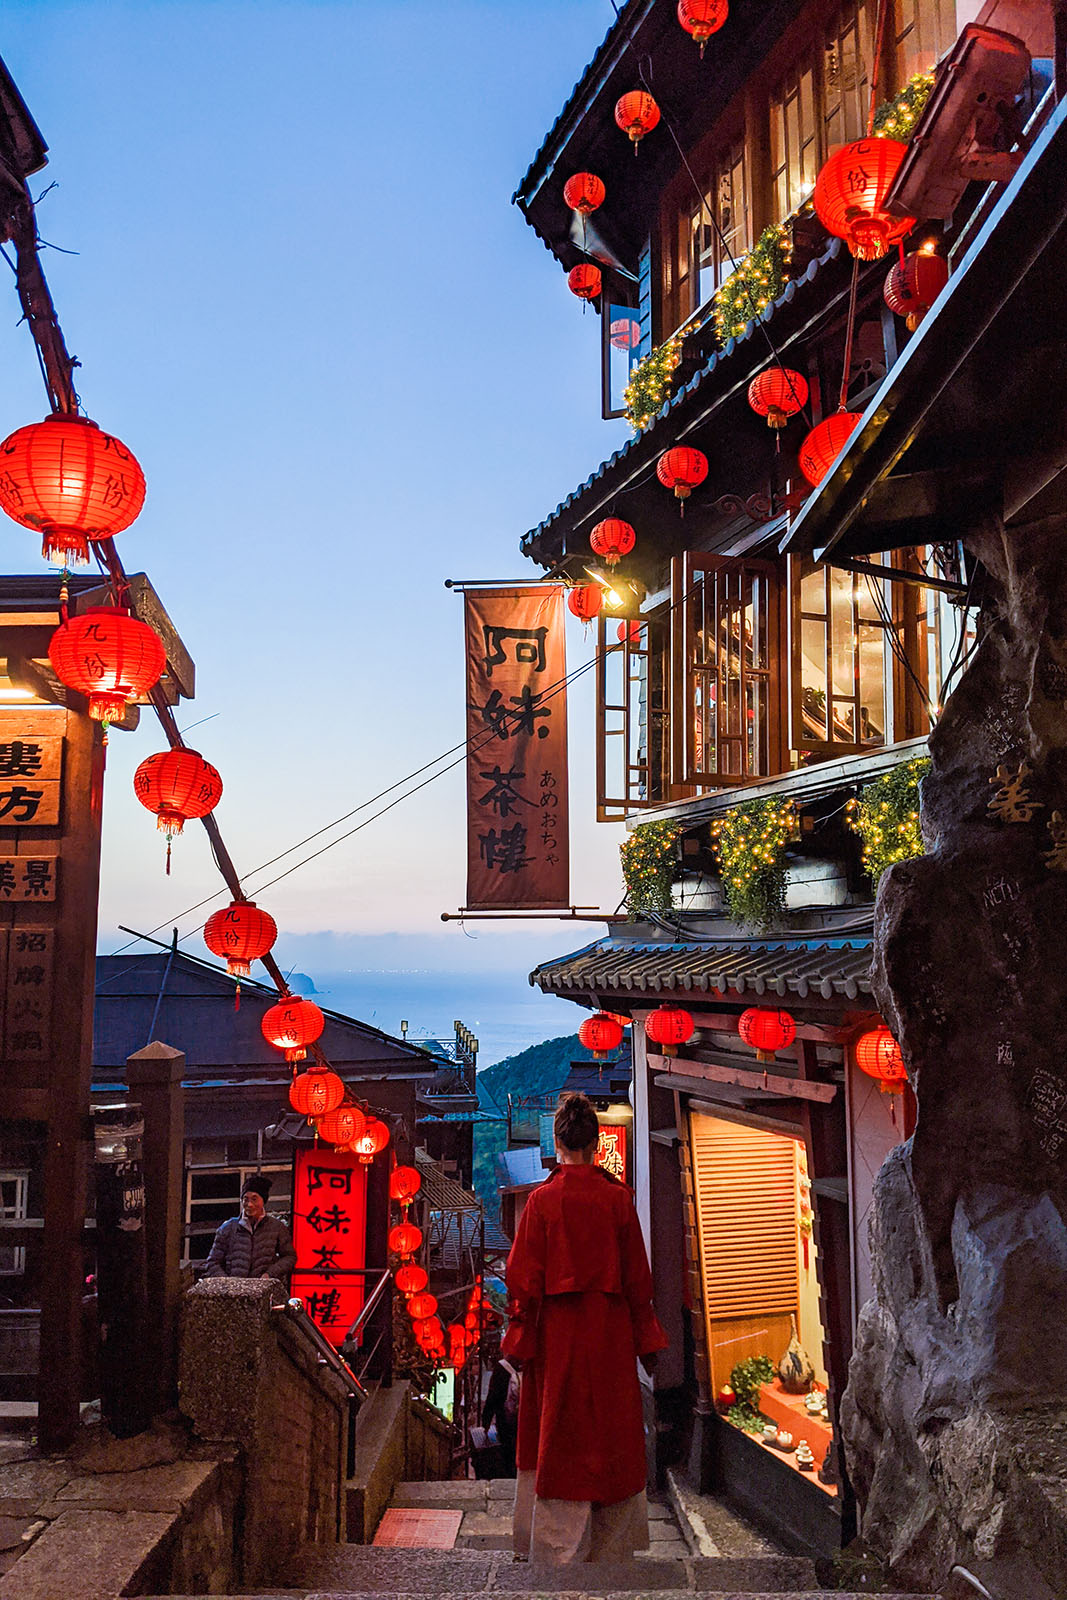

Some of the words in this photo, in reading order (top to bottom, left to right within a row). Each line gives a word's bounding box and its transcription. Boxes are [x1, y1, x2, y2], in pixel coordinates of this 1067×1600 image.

[102, 435, 129, 509] 九份
[83, 624, 108, 679] 九份
[467, 624, 551, 874] 阿妹茶樓
[224, 909, 241, 948] 九份
[283, 1009, 298, 1041] 九份
[312, 1083, 325, 1112] 九份
[341, 1115, 352, 1139] 九份
[304, 1165, 354, 1325] 阿妹茶樓
